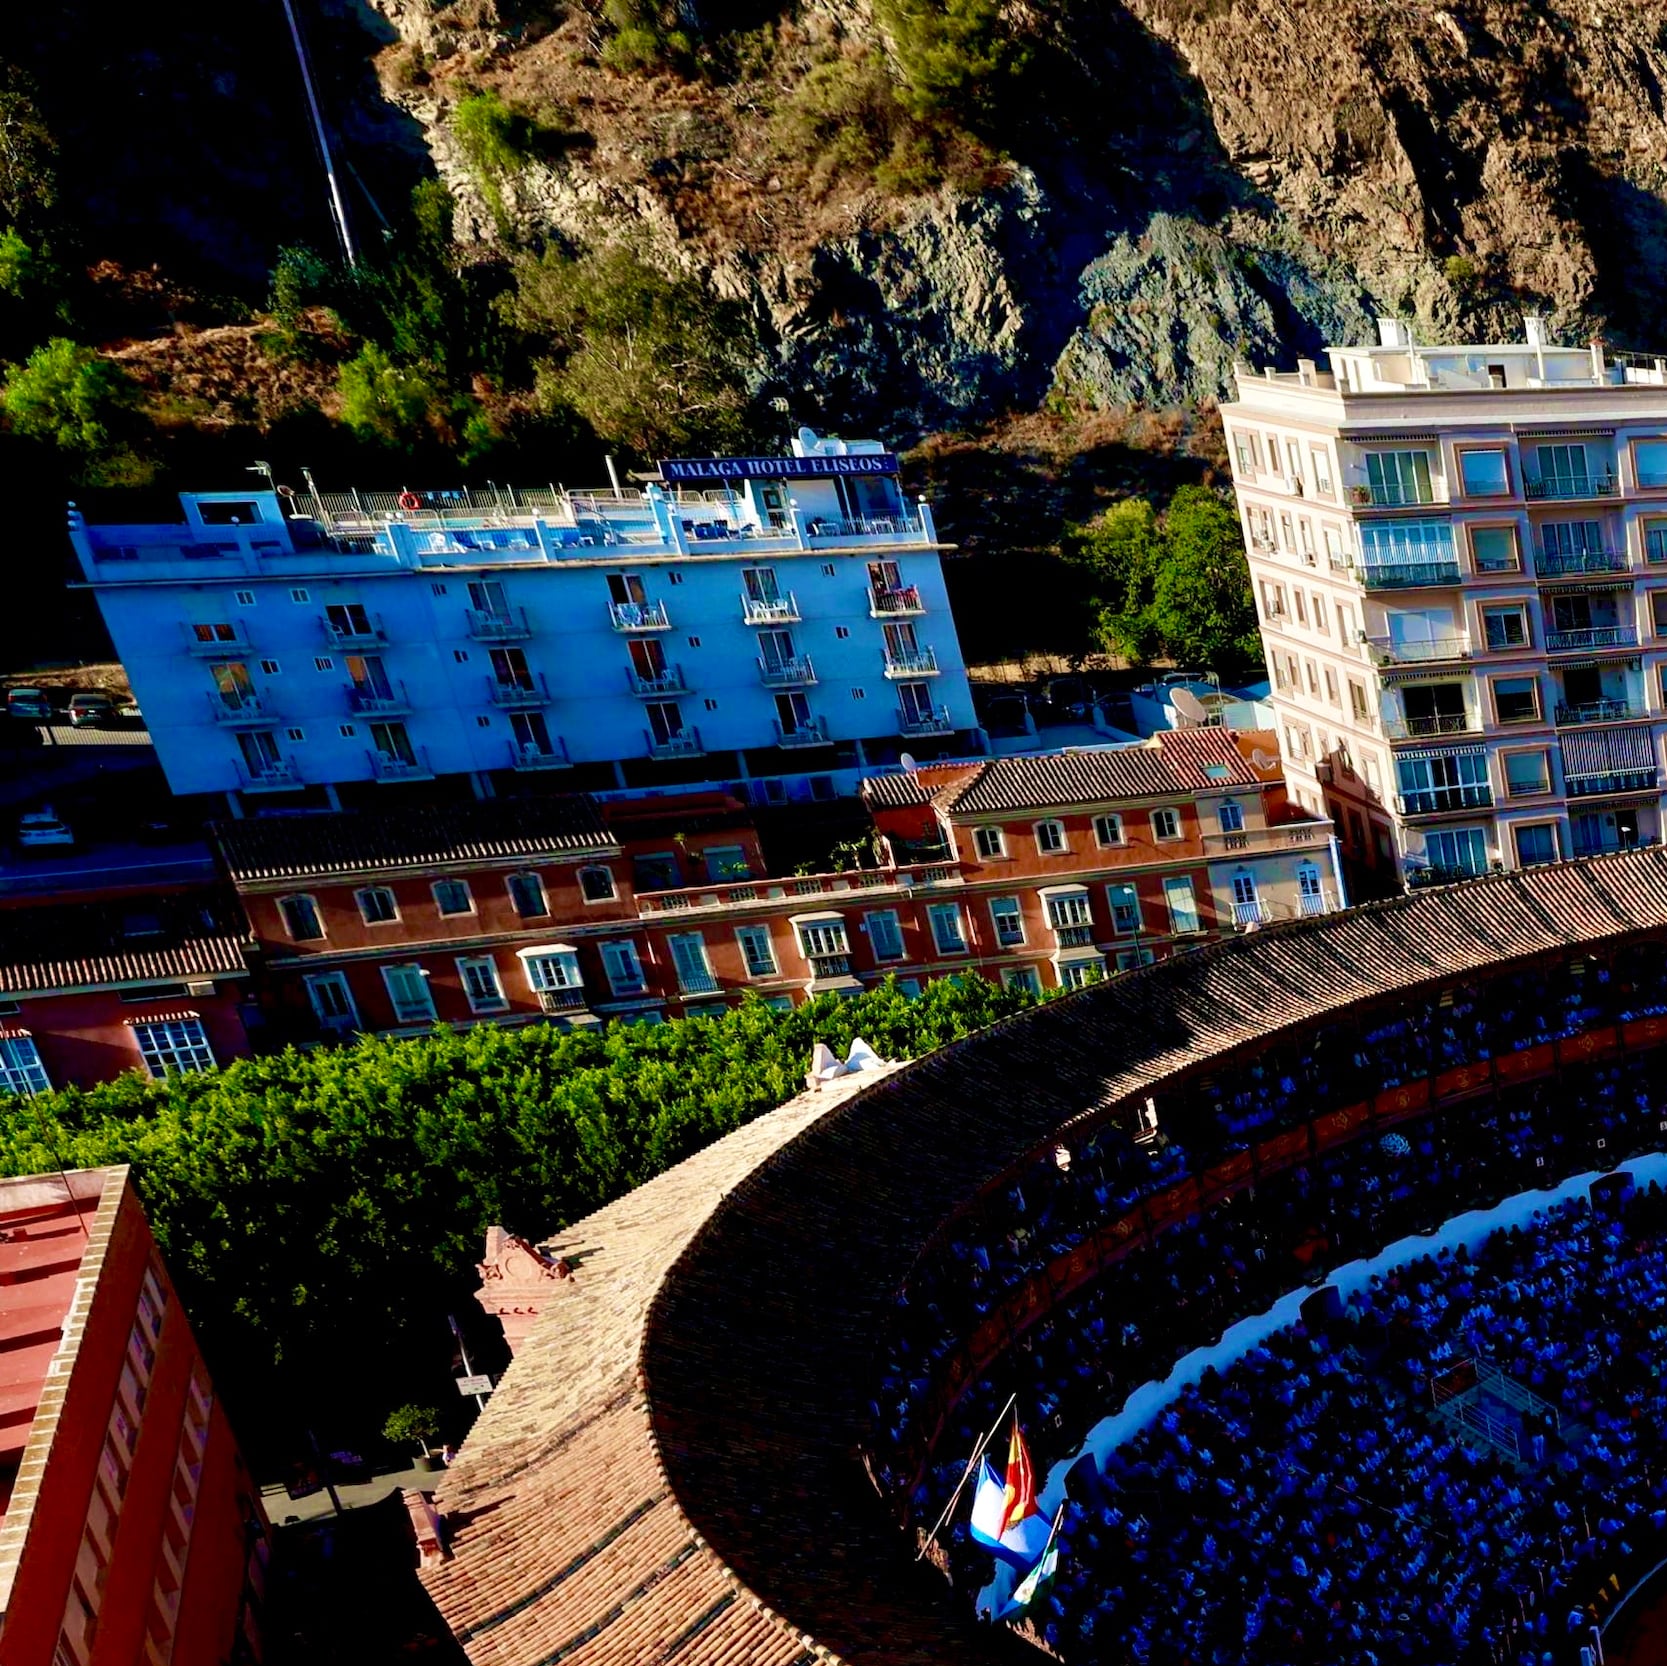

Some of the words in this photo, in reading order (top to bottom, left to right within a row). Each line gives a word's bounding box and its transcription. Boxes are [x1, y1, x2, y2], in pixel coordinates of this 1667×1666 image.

[670, 461, 743, 477] MALAGA
[748, 459, 807, 475] HOTEL
[811, 457, 882, 473] ELISEOS
